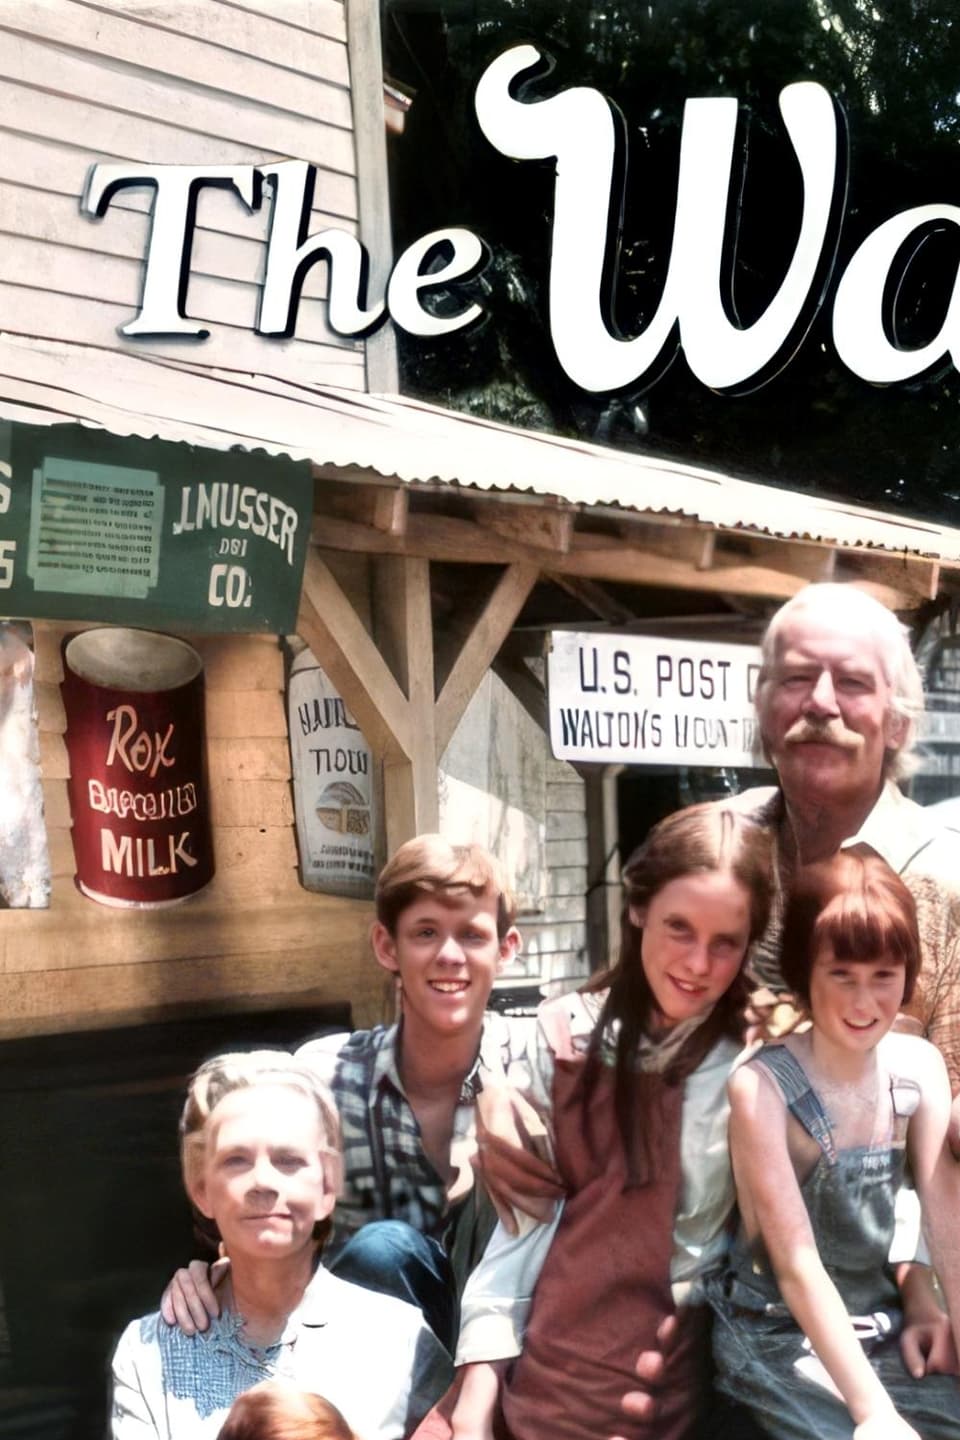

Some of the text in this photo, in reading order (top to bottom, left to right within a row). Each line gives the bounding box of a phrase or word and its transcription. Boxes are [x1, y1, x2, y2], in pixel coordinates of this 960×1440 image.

[578, 646, 638, 697] U.S.
[656, 654, 732, 702] POST
[100, 828, 198, 878] MILK
